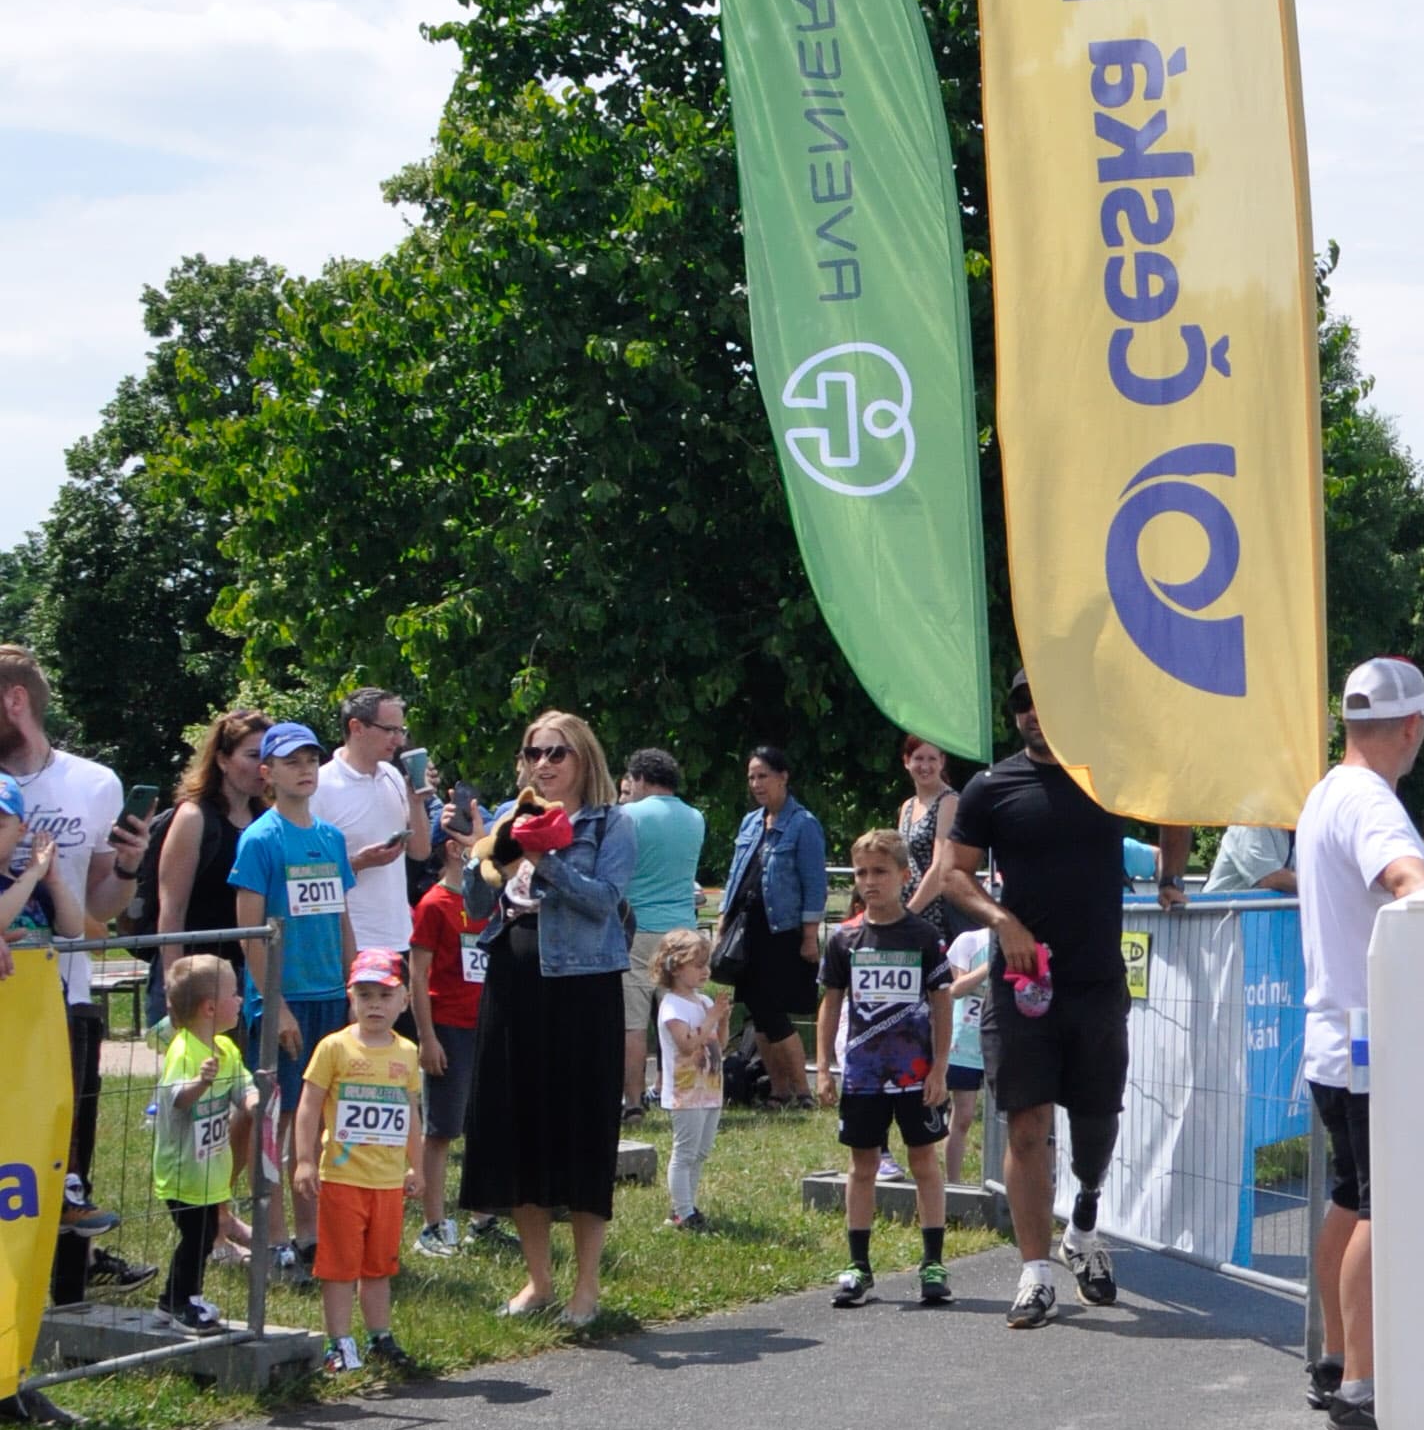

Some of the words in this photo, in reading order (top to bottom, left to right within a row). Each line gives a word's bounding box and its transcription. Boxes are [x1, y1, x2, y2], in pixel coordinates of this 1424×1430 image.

[297, 881, 336, 903] 2011
[469, 951, 489, 970] 20
[859, 969, 912, 990] 2140
[345, 1105, 405, 1132] 2076
